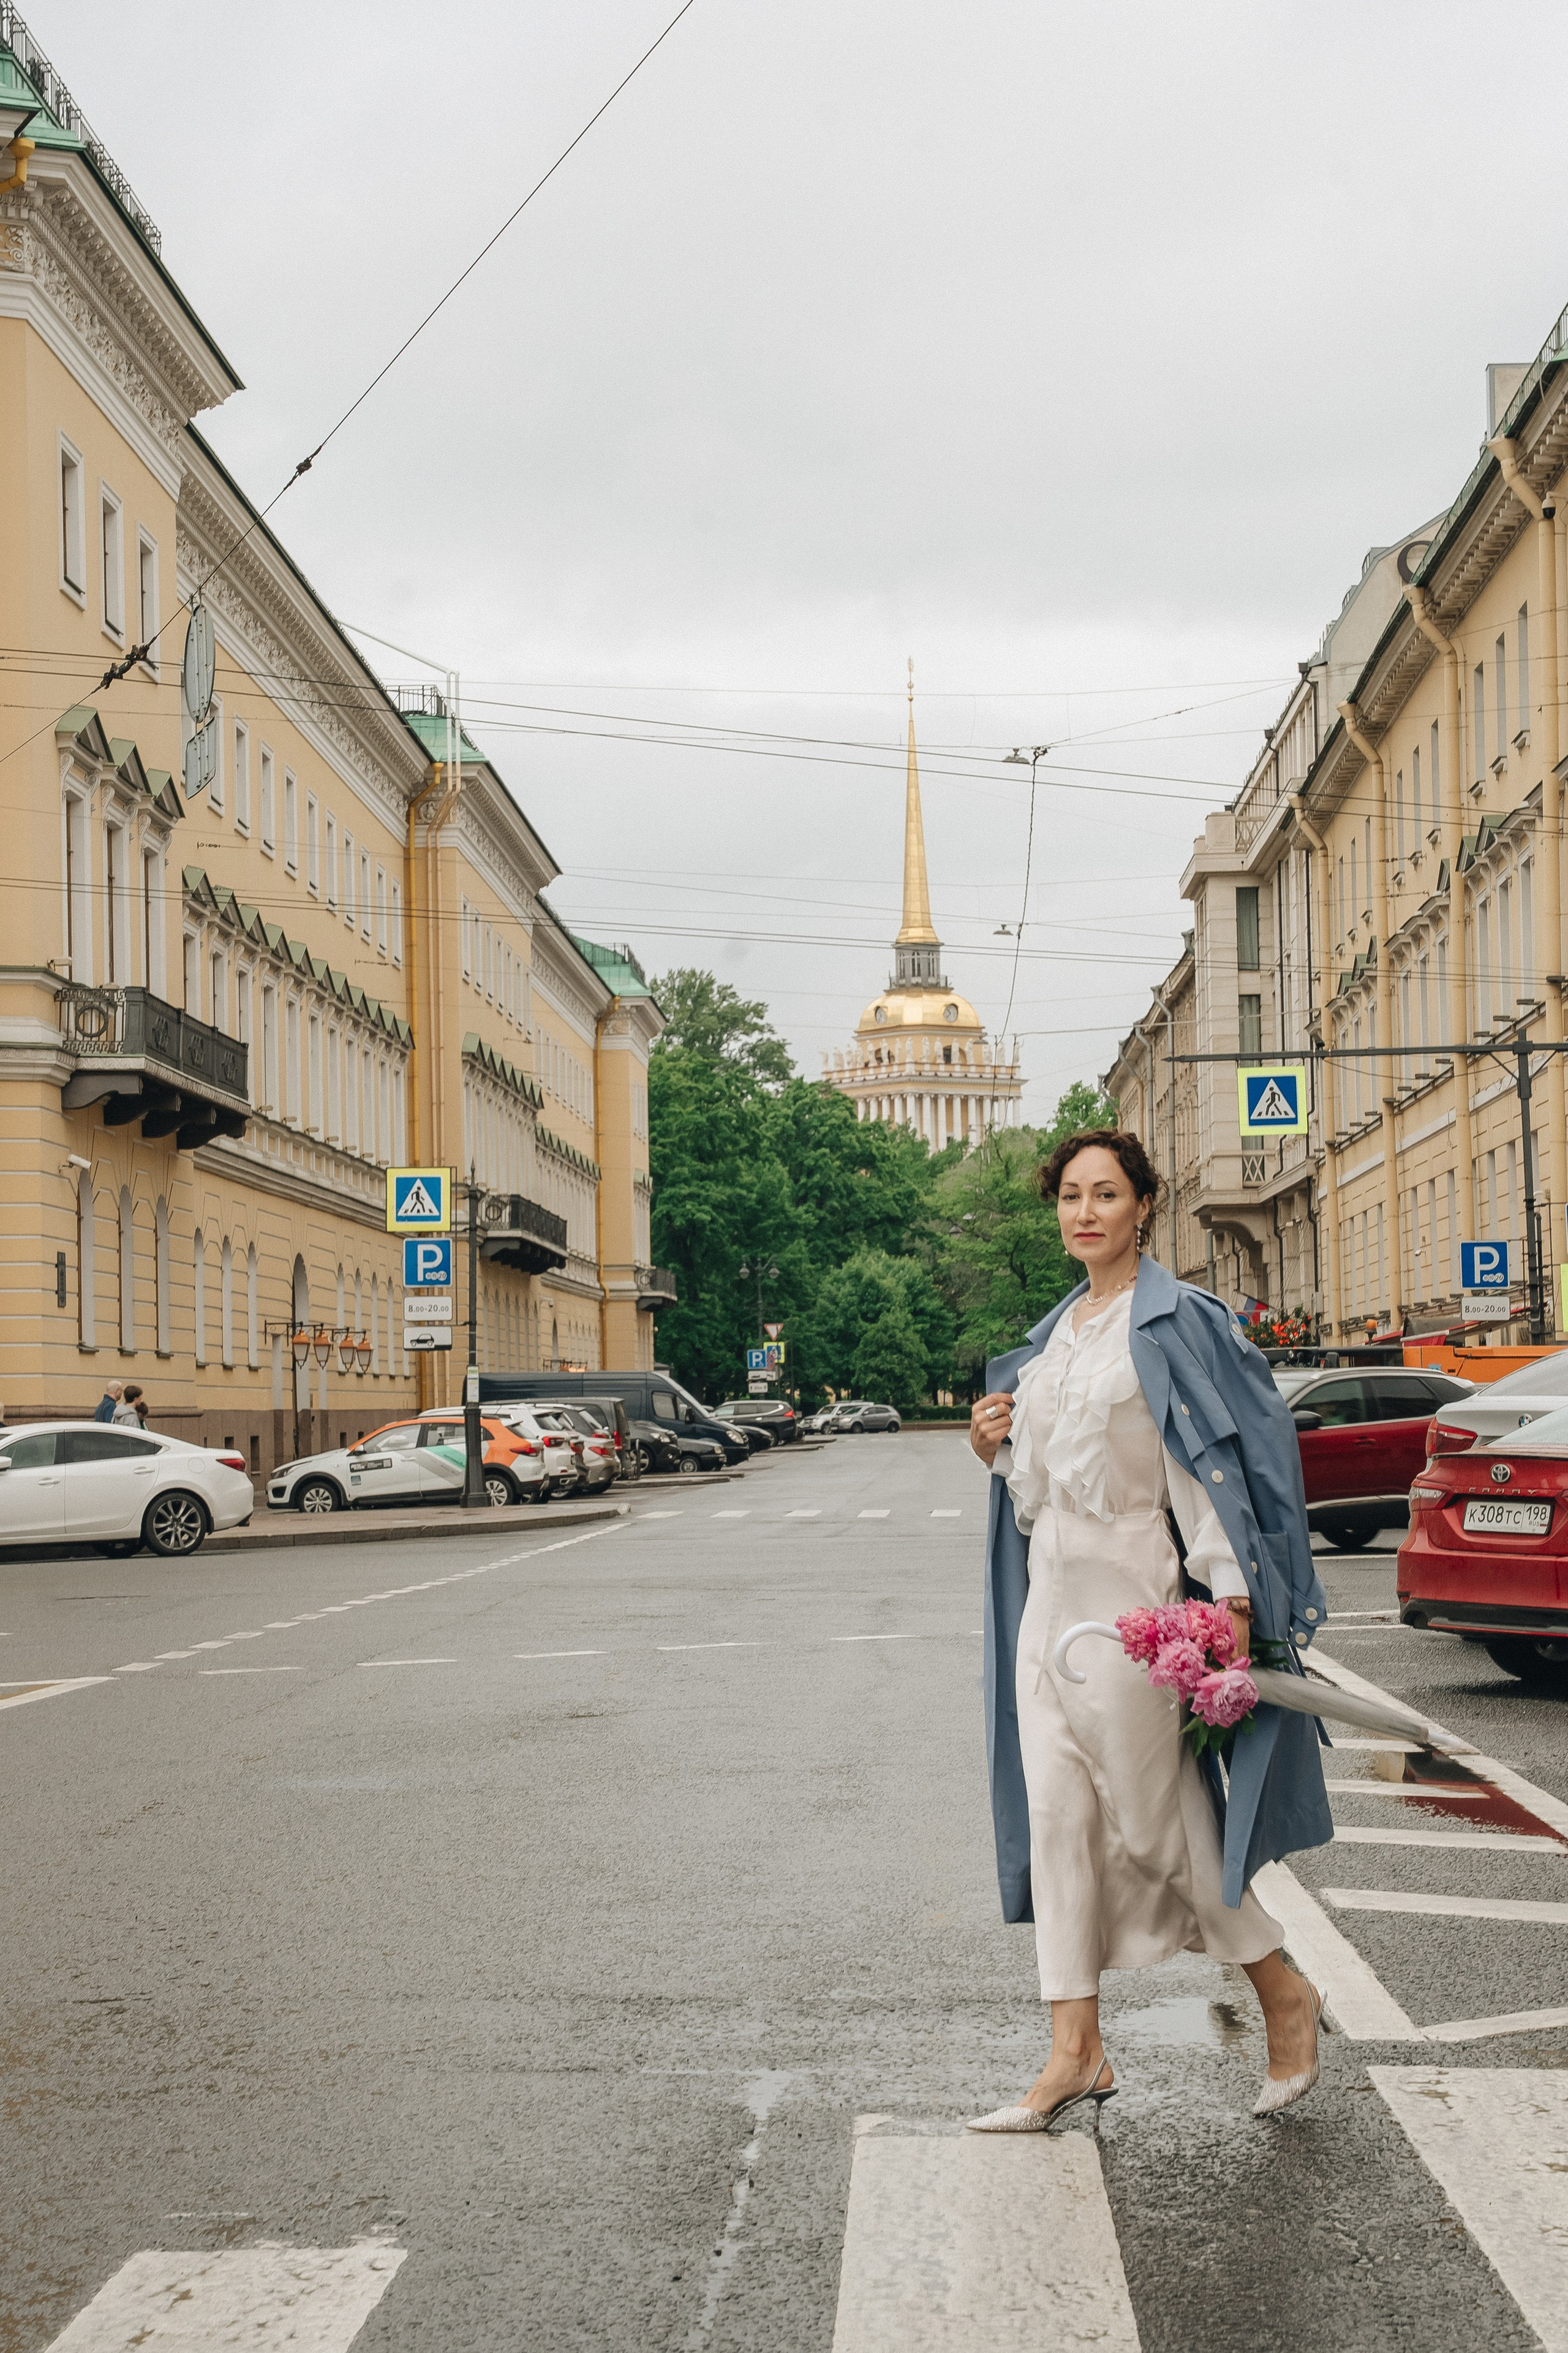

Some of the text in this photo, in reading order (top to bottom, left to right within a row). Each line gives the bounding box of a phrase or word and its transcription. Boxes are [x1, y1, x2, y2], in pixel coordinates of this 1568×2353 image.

[417, 1244, 443, 1282] P
[1474, 1246, 1500, 1284] P
[752, 1352, 763, 1367] P
[1526, 1505, 1547, 1520] 198
